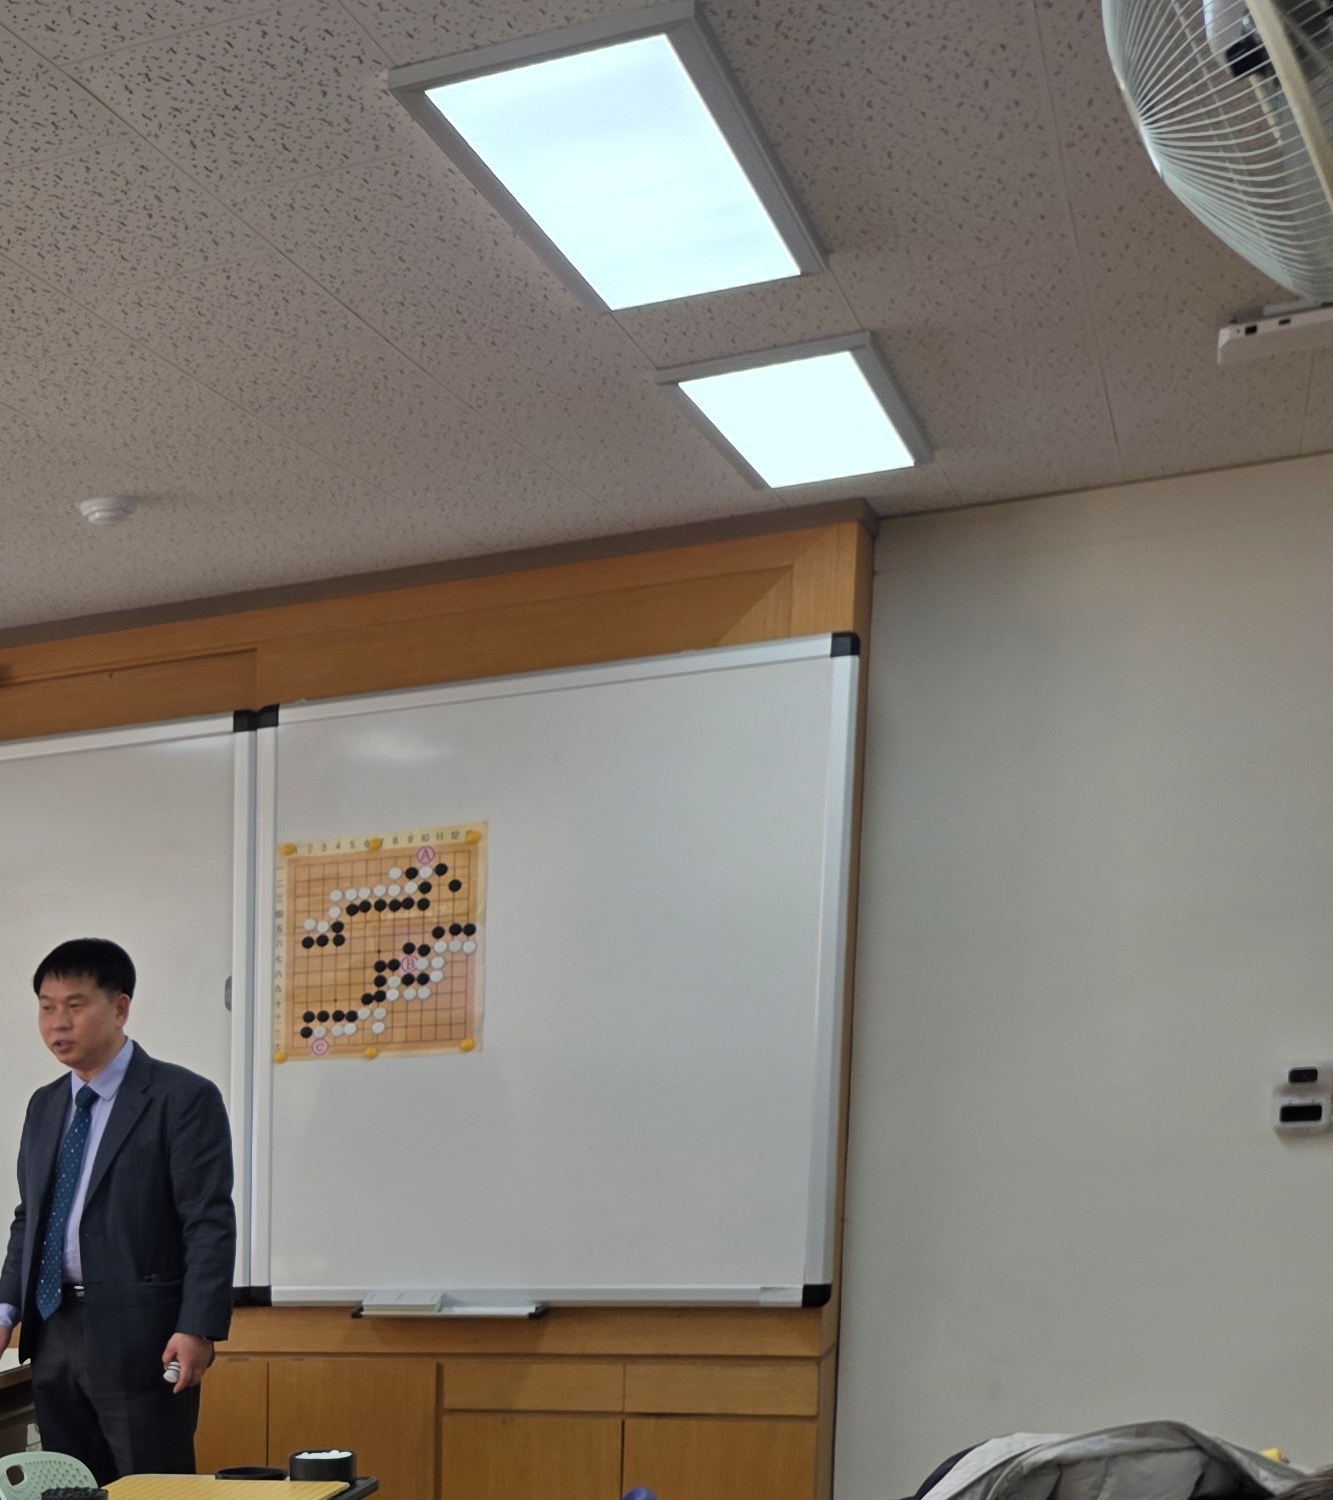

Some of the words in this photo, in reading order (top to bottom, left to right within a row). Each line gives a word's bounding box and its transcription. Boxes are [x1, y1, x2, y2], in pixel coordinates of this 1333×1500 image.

[421, 833, 430, 843] 10
[435, 831, 444, 841] 11
[451, 830, 460, 840] 12
[419, 847, 432, 861] A
